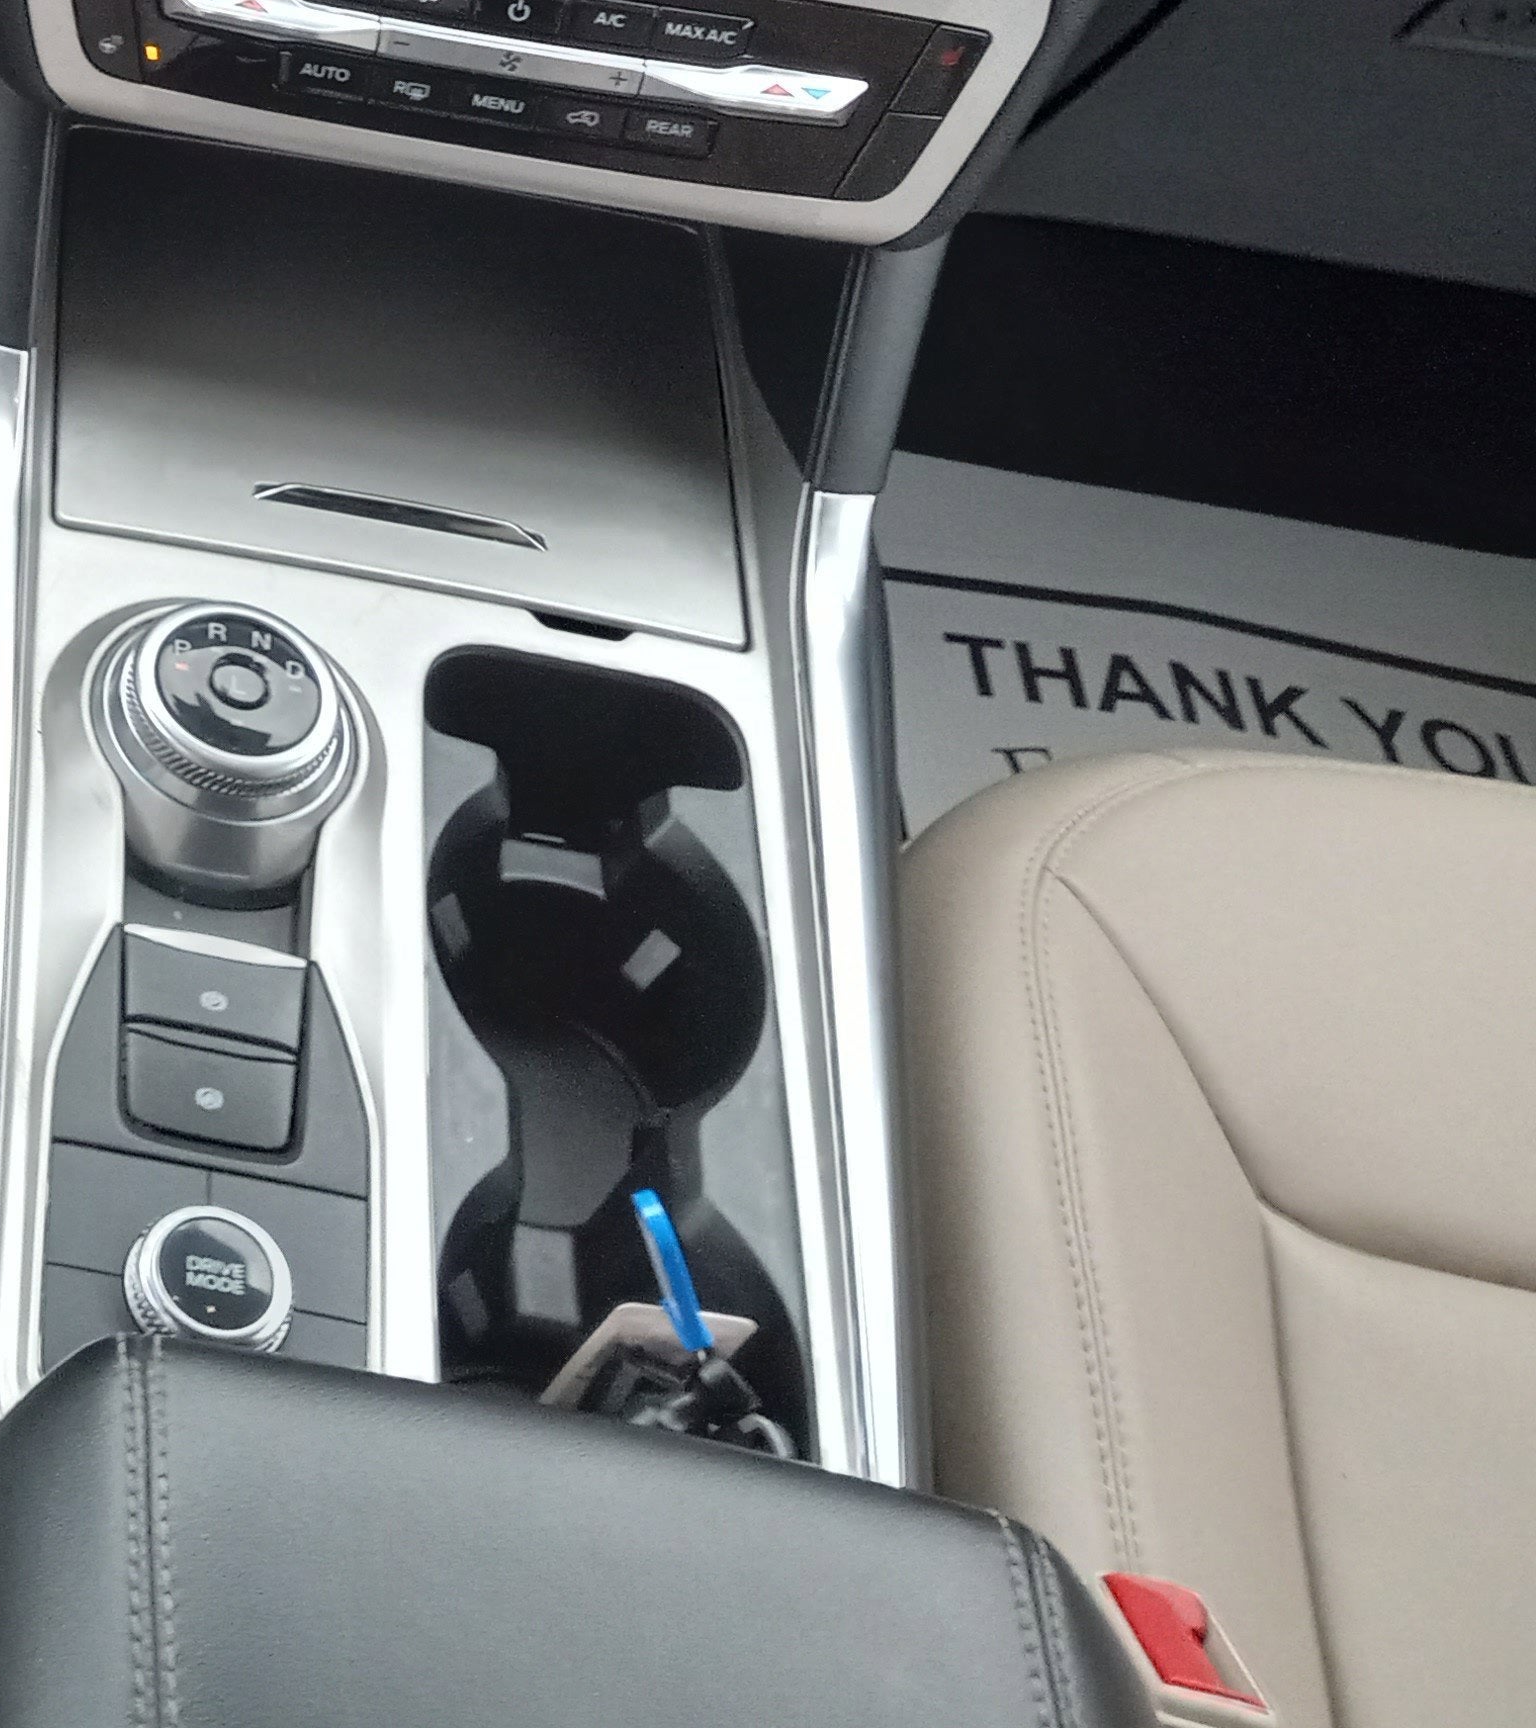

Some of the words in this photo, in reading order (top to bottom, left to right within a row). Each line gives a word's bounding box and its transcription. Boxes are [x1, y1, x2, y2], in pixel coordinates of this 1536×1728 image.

[593, 11, 627, 29] A/C
[665, 22, 706, 41] MAX
[706, 28, 739, 47] A/C
[299, 62, 352, 83] AUTO
[471, 94, 525, 114] MENU
[646, 119, 694, 138] REAR
[207, 622, 229, 642] R
[251, 630, 273, 651] N
[174, 638, 192, 656] P
[286, 660, 306, 680] D
[230, 674, 247, 695] L
[943, 632, 1330, 750] THANK
[185, 1254, 246, 1278] DRIVE
[185, 1271, 246, 1295] MODE
